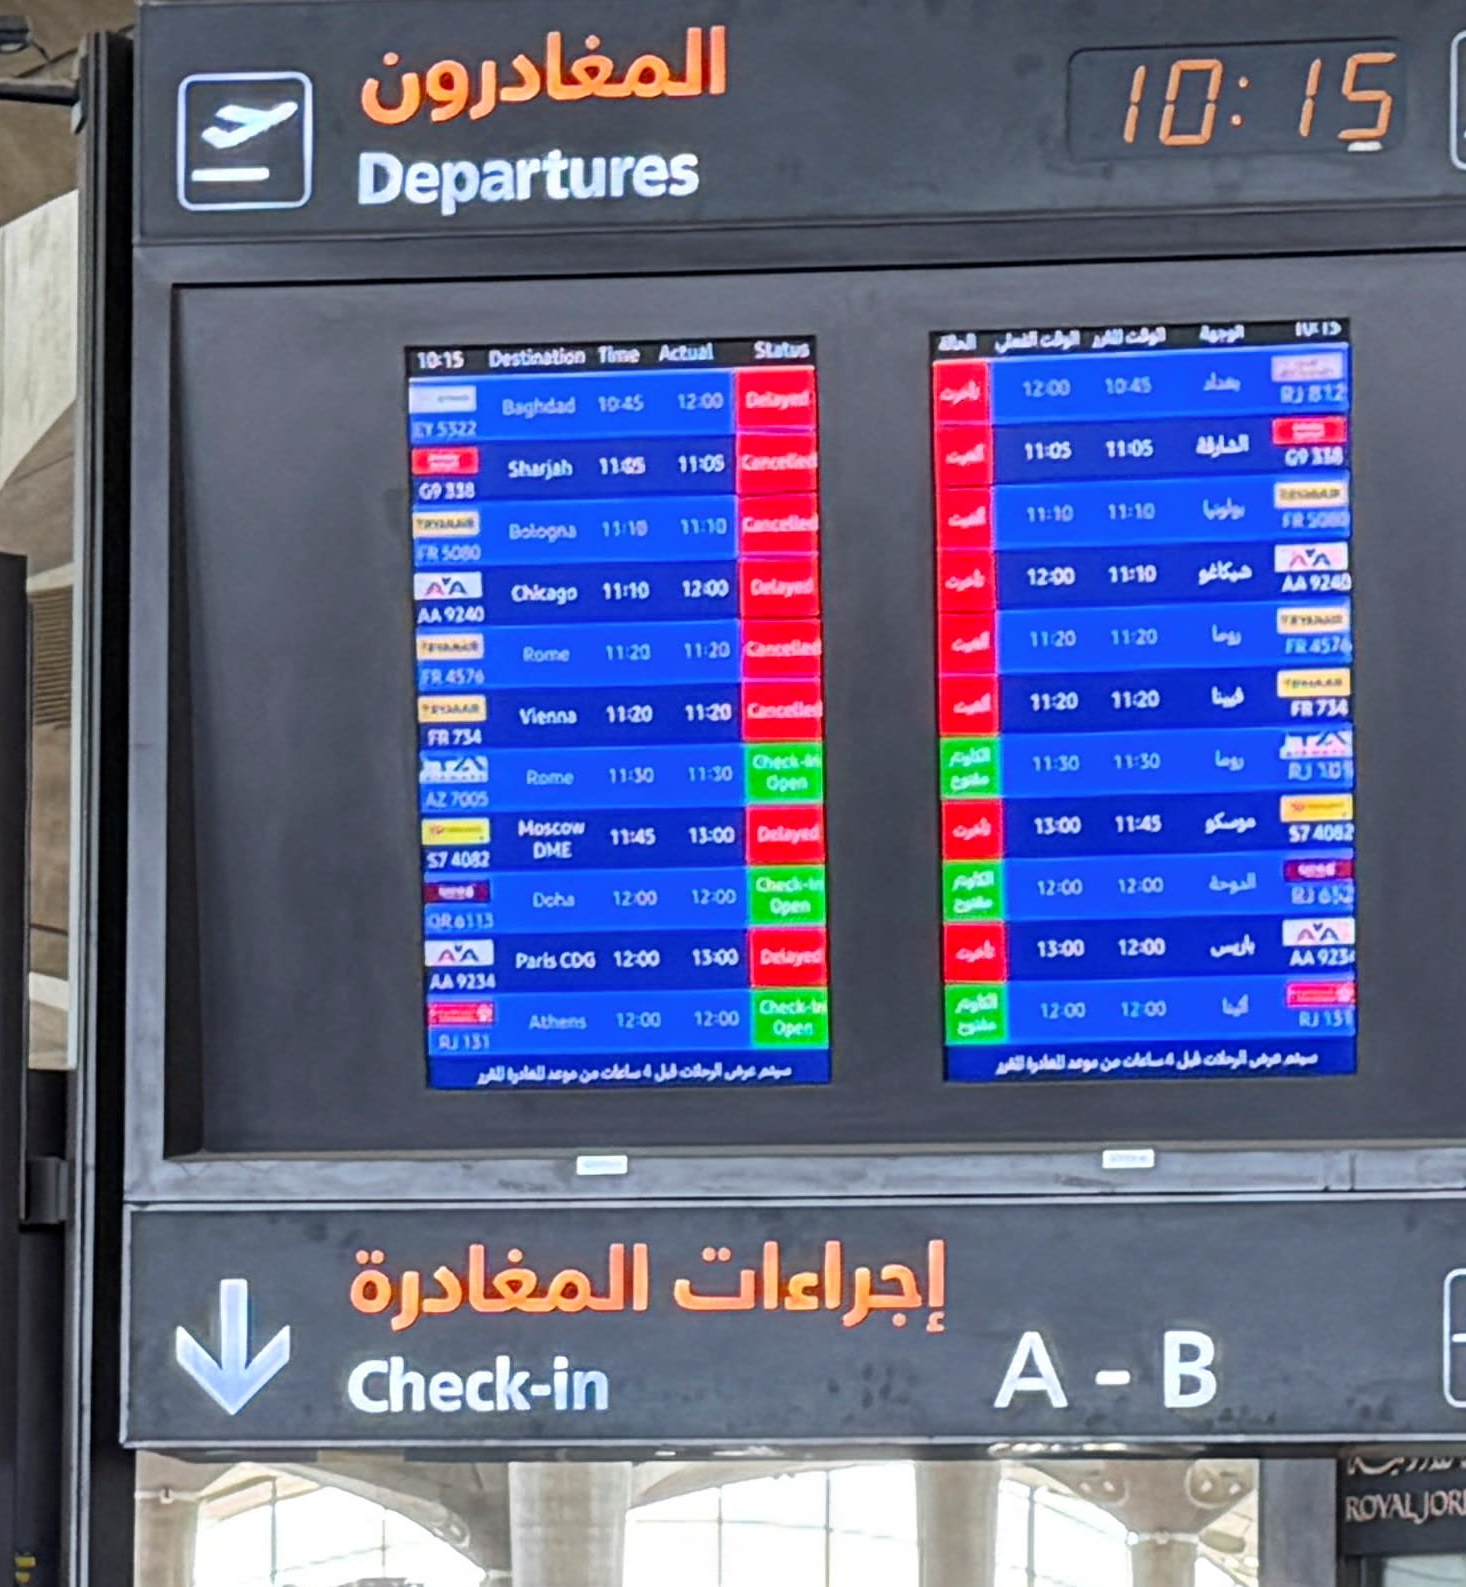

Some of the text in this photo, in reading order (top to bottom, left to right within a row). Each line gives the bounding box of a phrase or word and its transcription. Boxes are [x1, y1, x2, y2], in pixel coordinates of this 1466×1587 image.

[361, 26, 726, 125] المغادرون
[1118, 52, 1403, 152] 10:15
[359, 149, 699, 216] Departures
[418, 341, 809, 368] 10:15 Destination Time Actual Status
[1023, 379, 1070, 397] 12:00
[503, 397, 575, 418] Baghdad
[679, 392, 724, 409] 12:00
[746, 390, 811, 410] Delayed
[1025, 439, 1153, 460] 11:05 11:05
[508, 460, 572, 480] Sharjah
[679, 454, 725, 472] 11:05
[739, 450, 818, 472] Cancelled
[1028, 503, 1155, 521] 11:10 11:10
[510, 512, 819, 542] Bologna 11:10 11:10 Cancelled
[1028, 565, 1157, 585] 11:10 12:00
[511, 576, 817, 604] Chicago 11:10 12:00 Delayed
[417, 606, 484, 624] AA 9240
[1031, 629, 1157, 647] 11:20 11:20
[523, 637, 822, 662] Rome 11:20 11:20 Cancelled
[1031, 690, 1160, 711] 11:20 11:20
[520, 699, 823, 725] Vienna 11:20 11:20 Cancelled
[1033, 753, 1160, 771] 11:30 11:30
[527, 766, 733, 784] Rome 11:30 11:30
[766, 775, 808, 792] Open
[518, 820, 822, 845] Moscow 11:45 13:00 Delayed
[1035, 815, 1161, 834] 11:45 13:00
[534, 842, 571, 858] DME
[1038, 877, 1163, 895] 12:00 12:00
[533, 889, 736, 907] Doha 12:00 12:00
[770, 898, 811, 916] Open
[1038, 938, 1165, 957] 12:00 13:00
[516, 948, 824, 969] Paris CDG 12:00 13:00 Delayed
[430, 974, 453, 989] AA
[1042, 1001, 1166, 1018] 12:00 12:00
[530, 1011, 739, 1029] Athens 12:00 12:00
[774, 1020, 812, 1037] Open
[350, 1240, 945, 1332] إجراءات المغادرة
[994, 1331, 1068, 1408] A
[1164, 1331, 1216, 1408] B
[347, 1355, 608, 1413] Check-in
[1346, 1493, 1416, 1523] ROYAL
